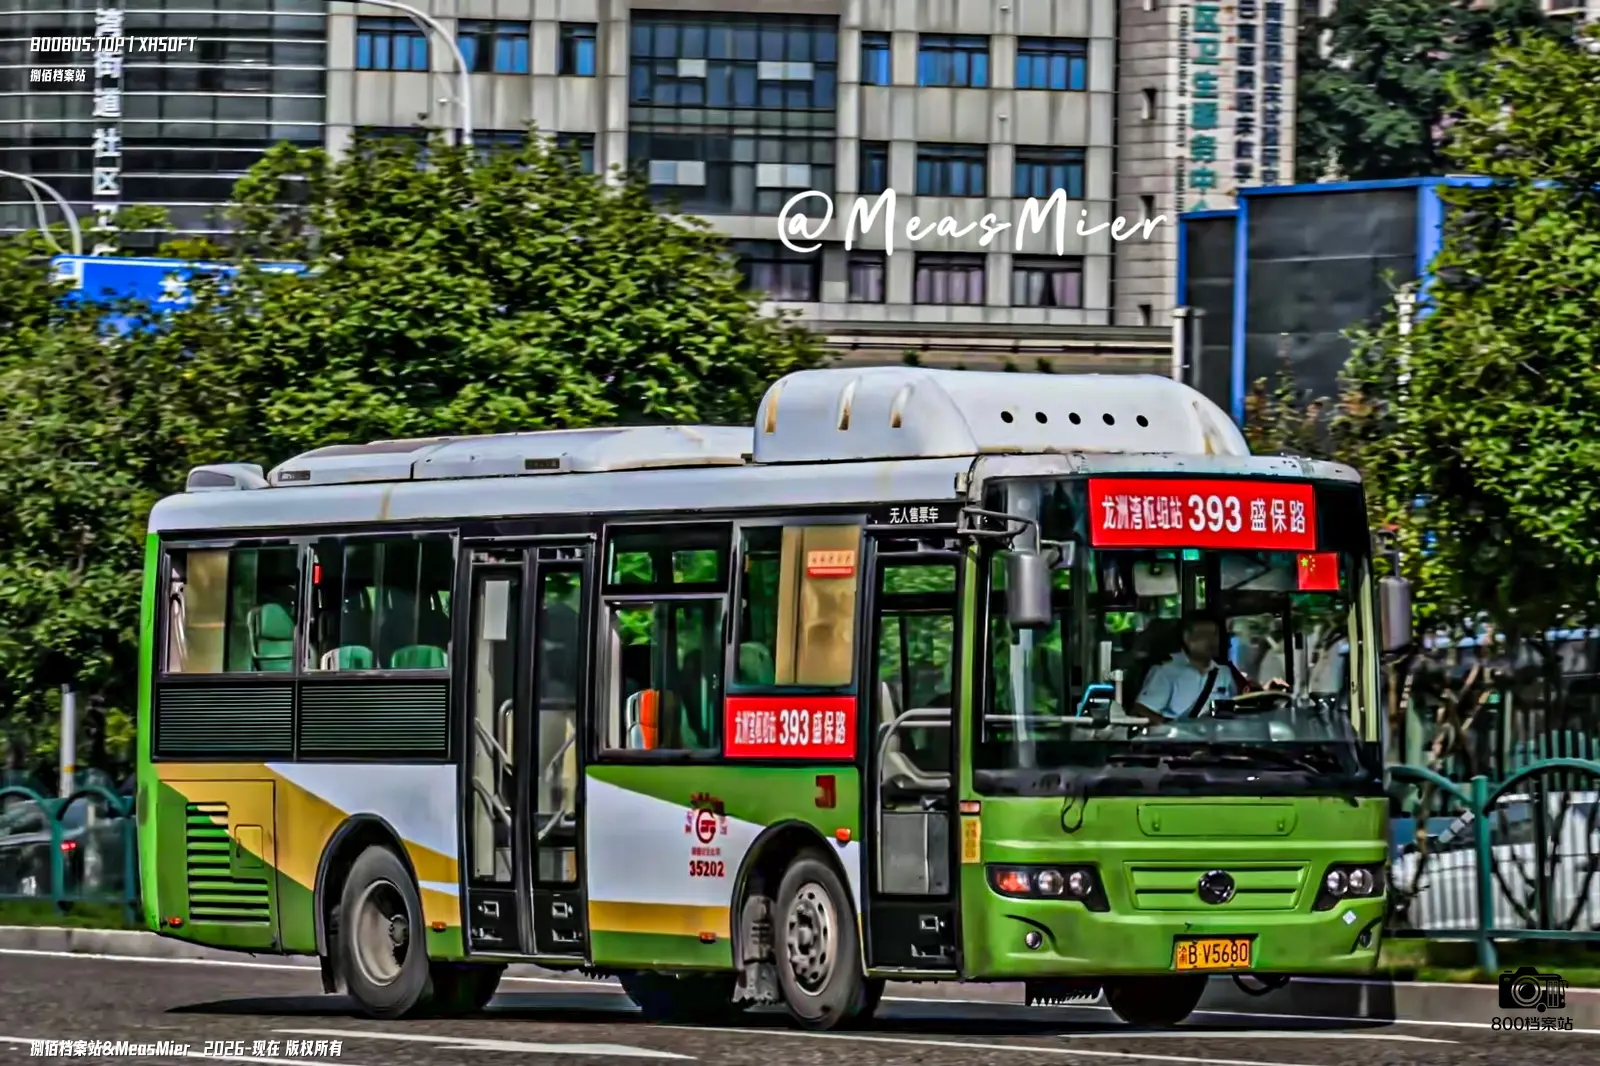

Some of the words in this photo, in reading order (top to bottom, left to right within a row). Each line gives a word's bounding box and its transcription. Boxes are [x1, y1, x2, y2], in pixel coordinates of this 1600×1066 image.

[889, 506, 939, 524] 无人售票车
[1188, 494, 1242, 533] 393
[1250, 498, 1305, 534] 盛保路
[780, 709, 810, 746] 393
[689, 860, 724, 877] 35202
